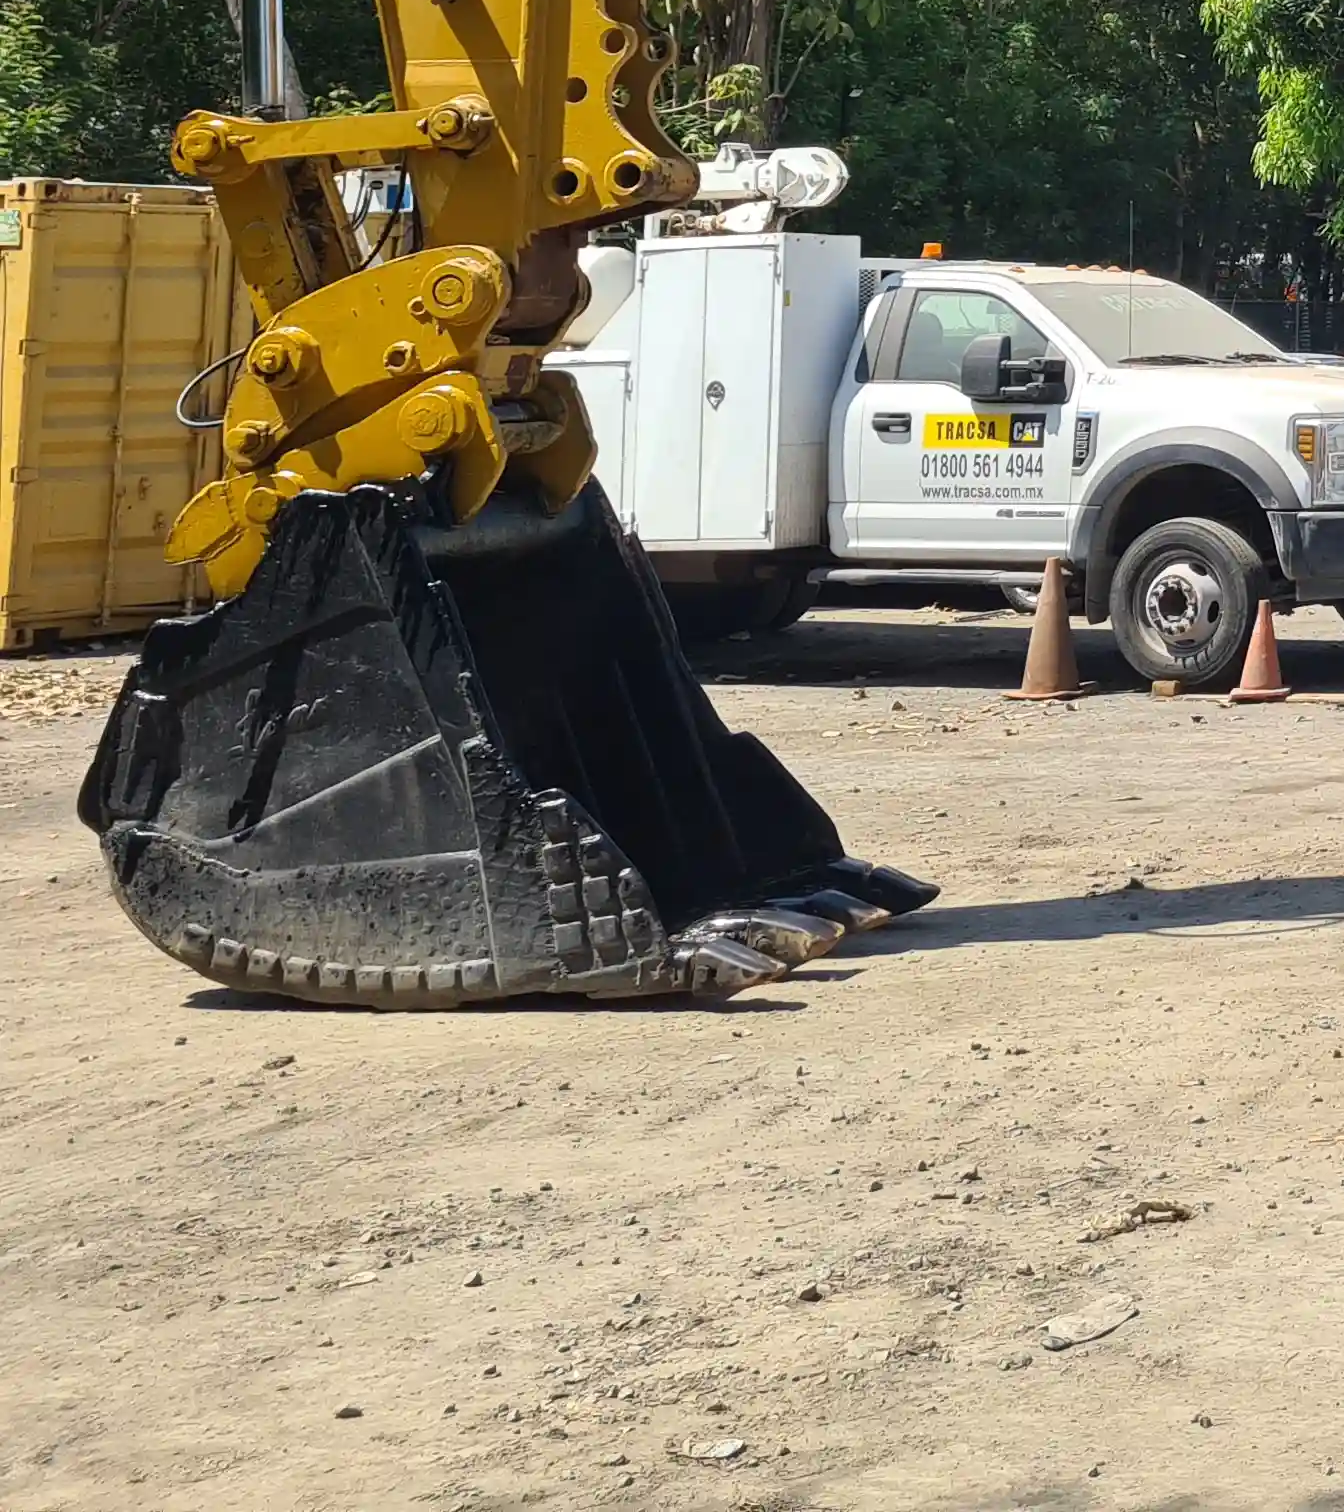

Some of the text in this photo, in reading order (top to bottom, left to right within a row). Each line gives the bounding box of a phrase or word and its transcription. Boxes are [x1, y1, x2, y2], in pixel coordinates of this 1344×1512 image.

[936, 421, 1043, 441] TRACSA CAT
[921, 453, 1044, 478] 01800 561 4944
[922, 485, 1044, 498] www.tracsa.com.mx
